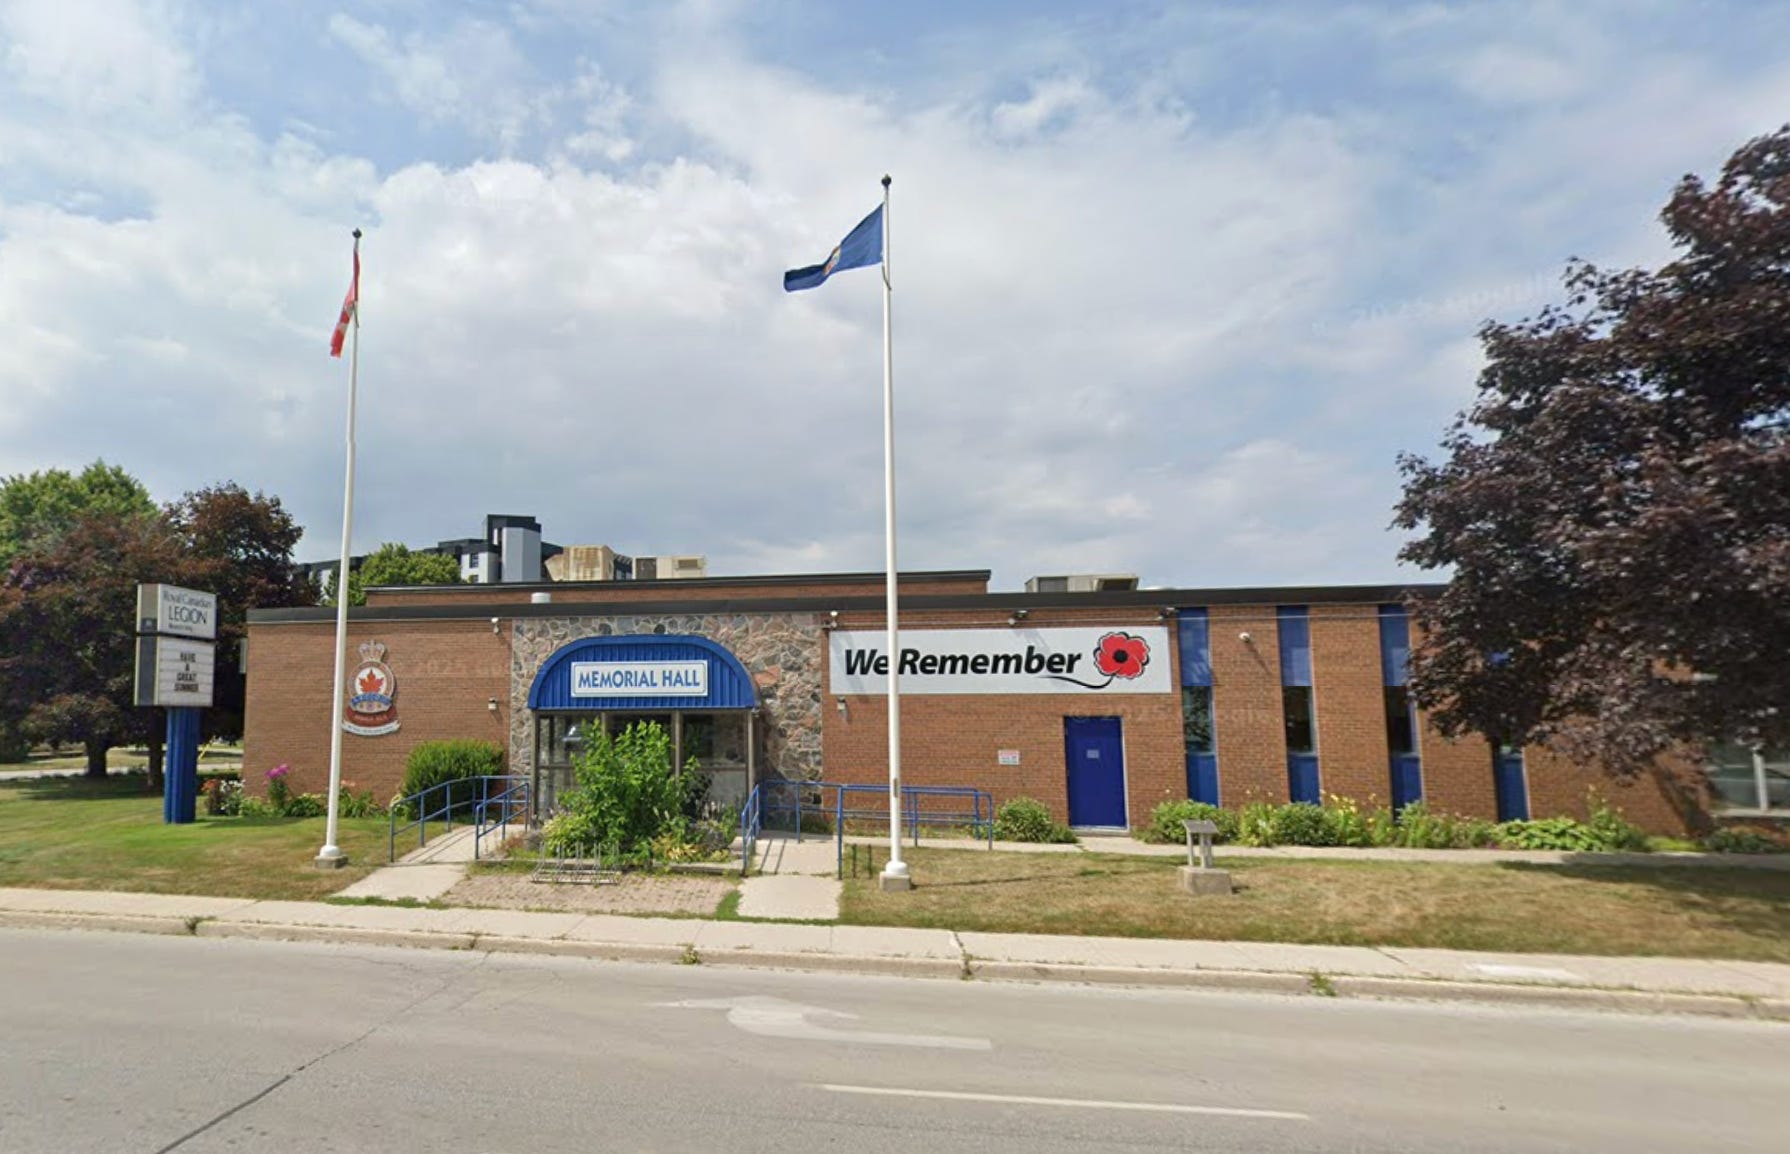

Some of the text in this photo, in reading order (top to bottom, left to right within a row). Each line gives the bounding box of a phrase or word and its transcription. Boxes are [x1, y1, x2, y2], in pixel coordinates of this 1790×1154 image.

[168, 606, 207, 624] LEGION
[185, 663, 190, 671] A
[845, 646, 1082, 675] We Remember
[177, 672, 197, 681] GREAT
[578, 669, 700, 688] MEMORIAL HALL
